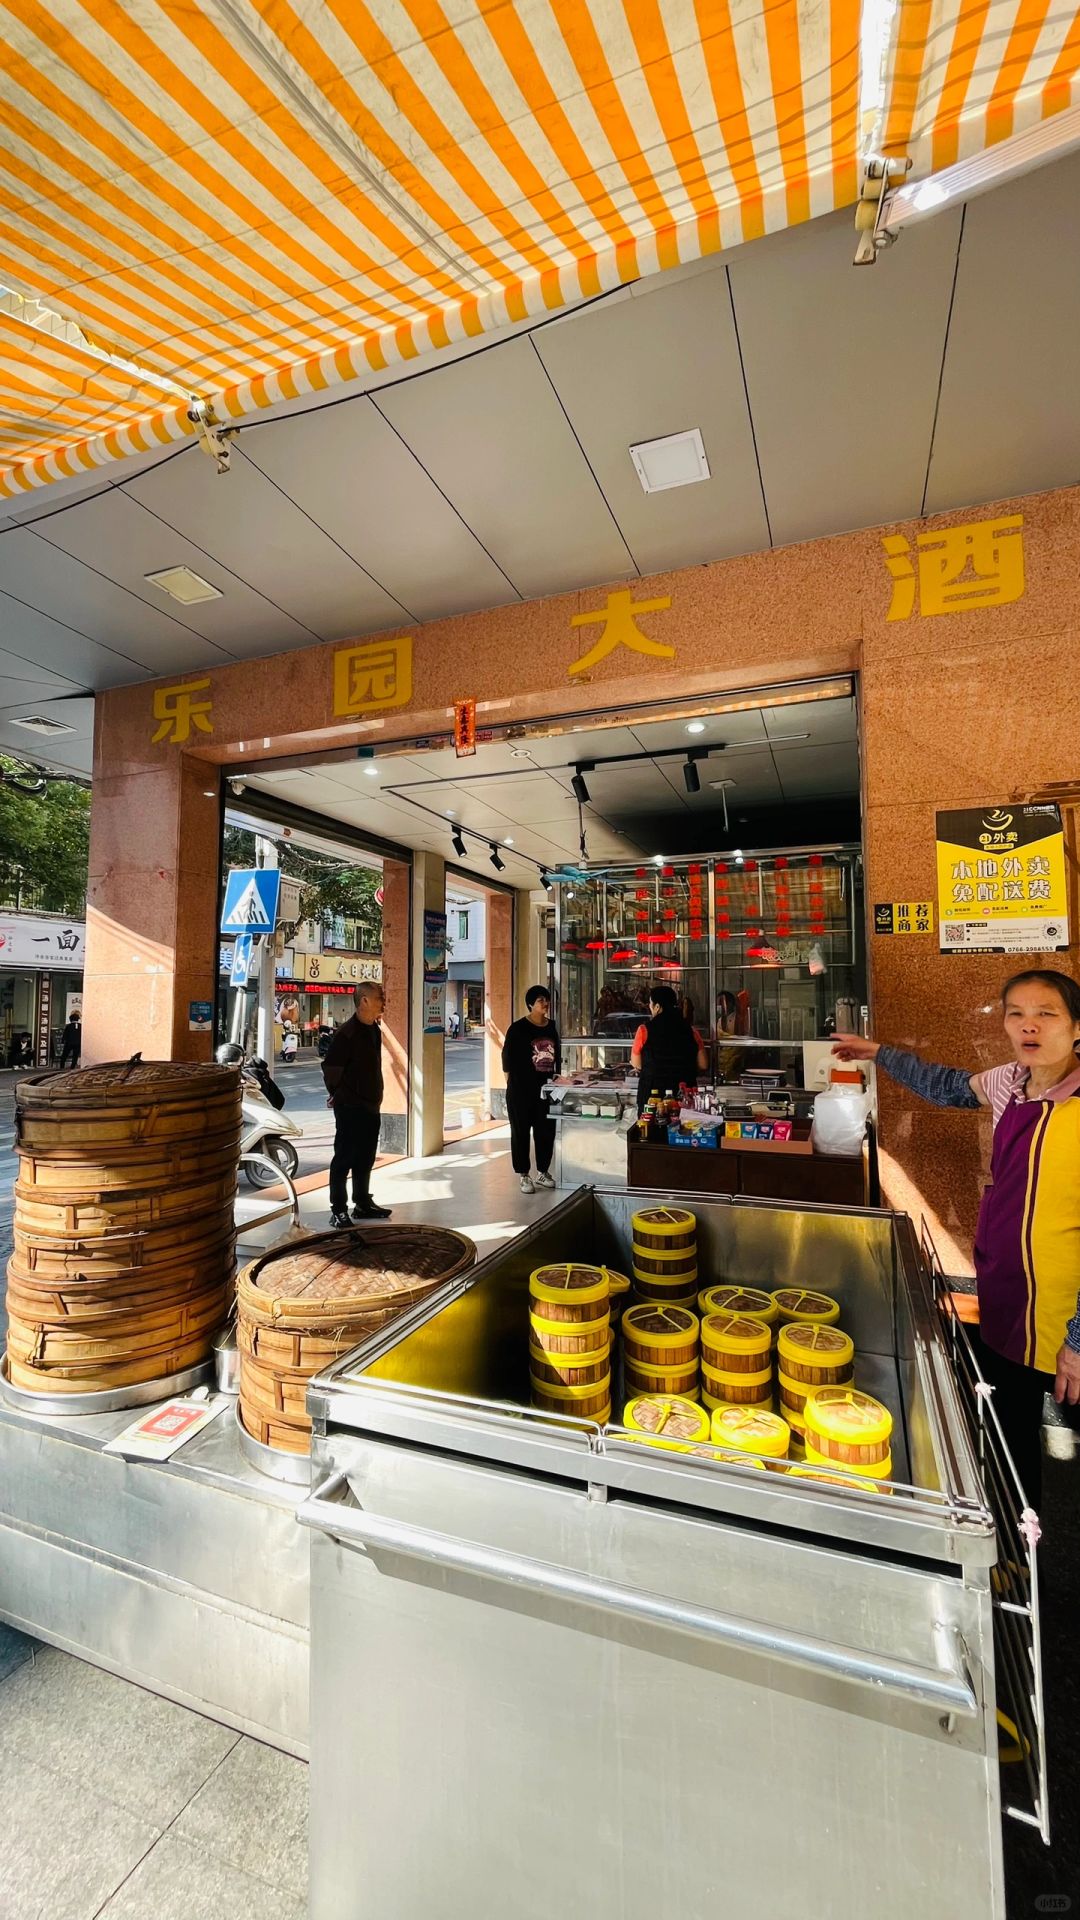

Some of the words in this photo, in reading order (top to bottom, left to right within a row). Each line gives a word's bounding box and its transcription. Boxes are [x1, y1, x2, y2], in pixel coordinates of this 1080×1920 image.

[951, 856, 1050, 880] 本地外卖
[952, 879, 1051, 903] 免配送费
[898, 919, 929, 931] 商家
[31, 929, 85, 952] 一面
